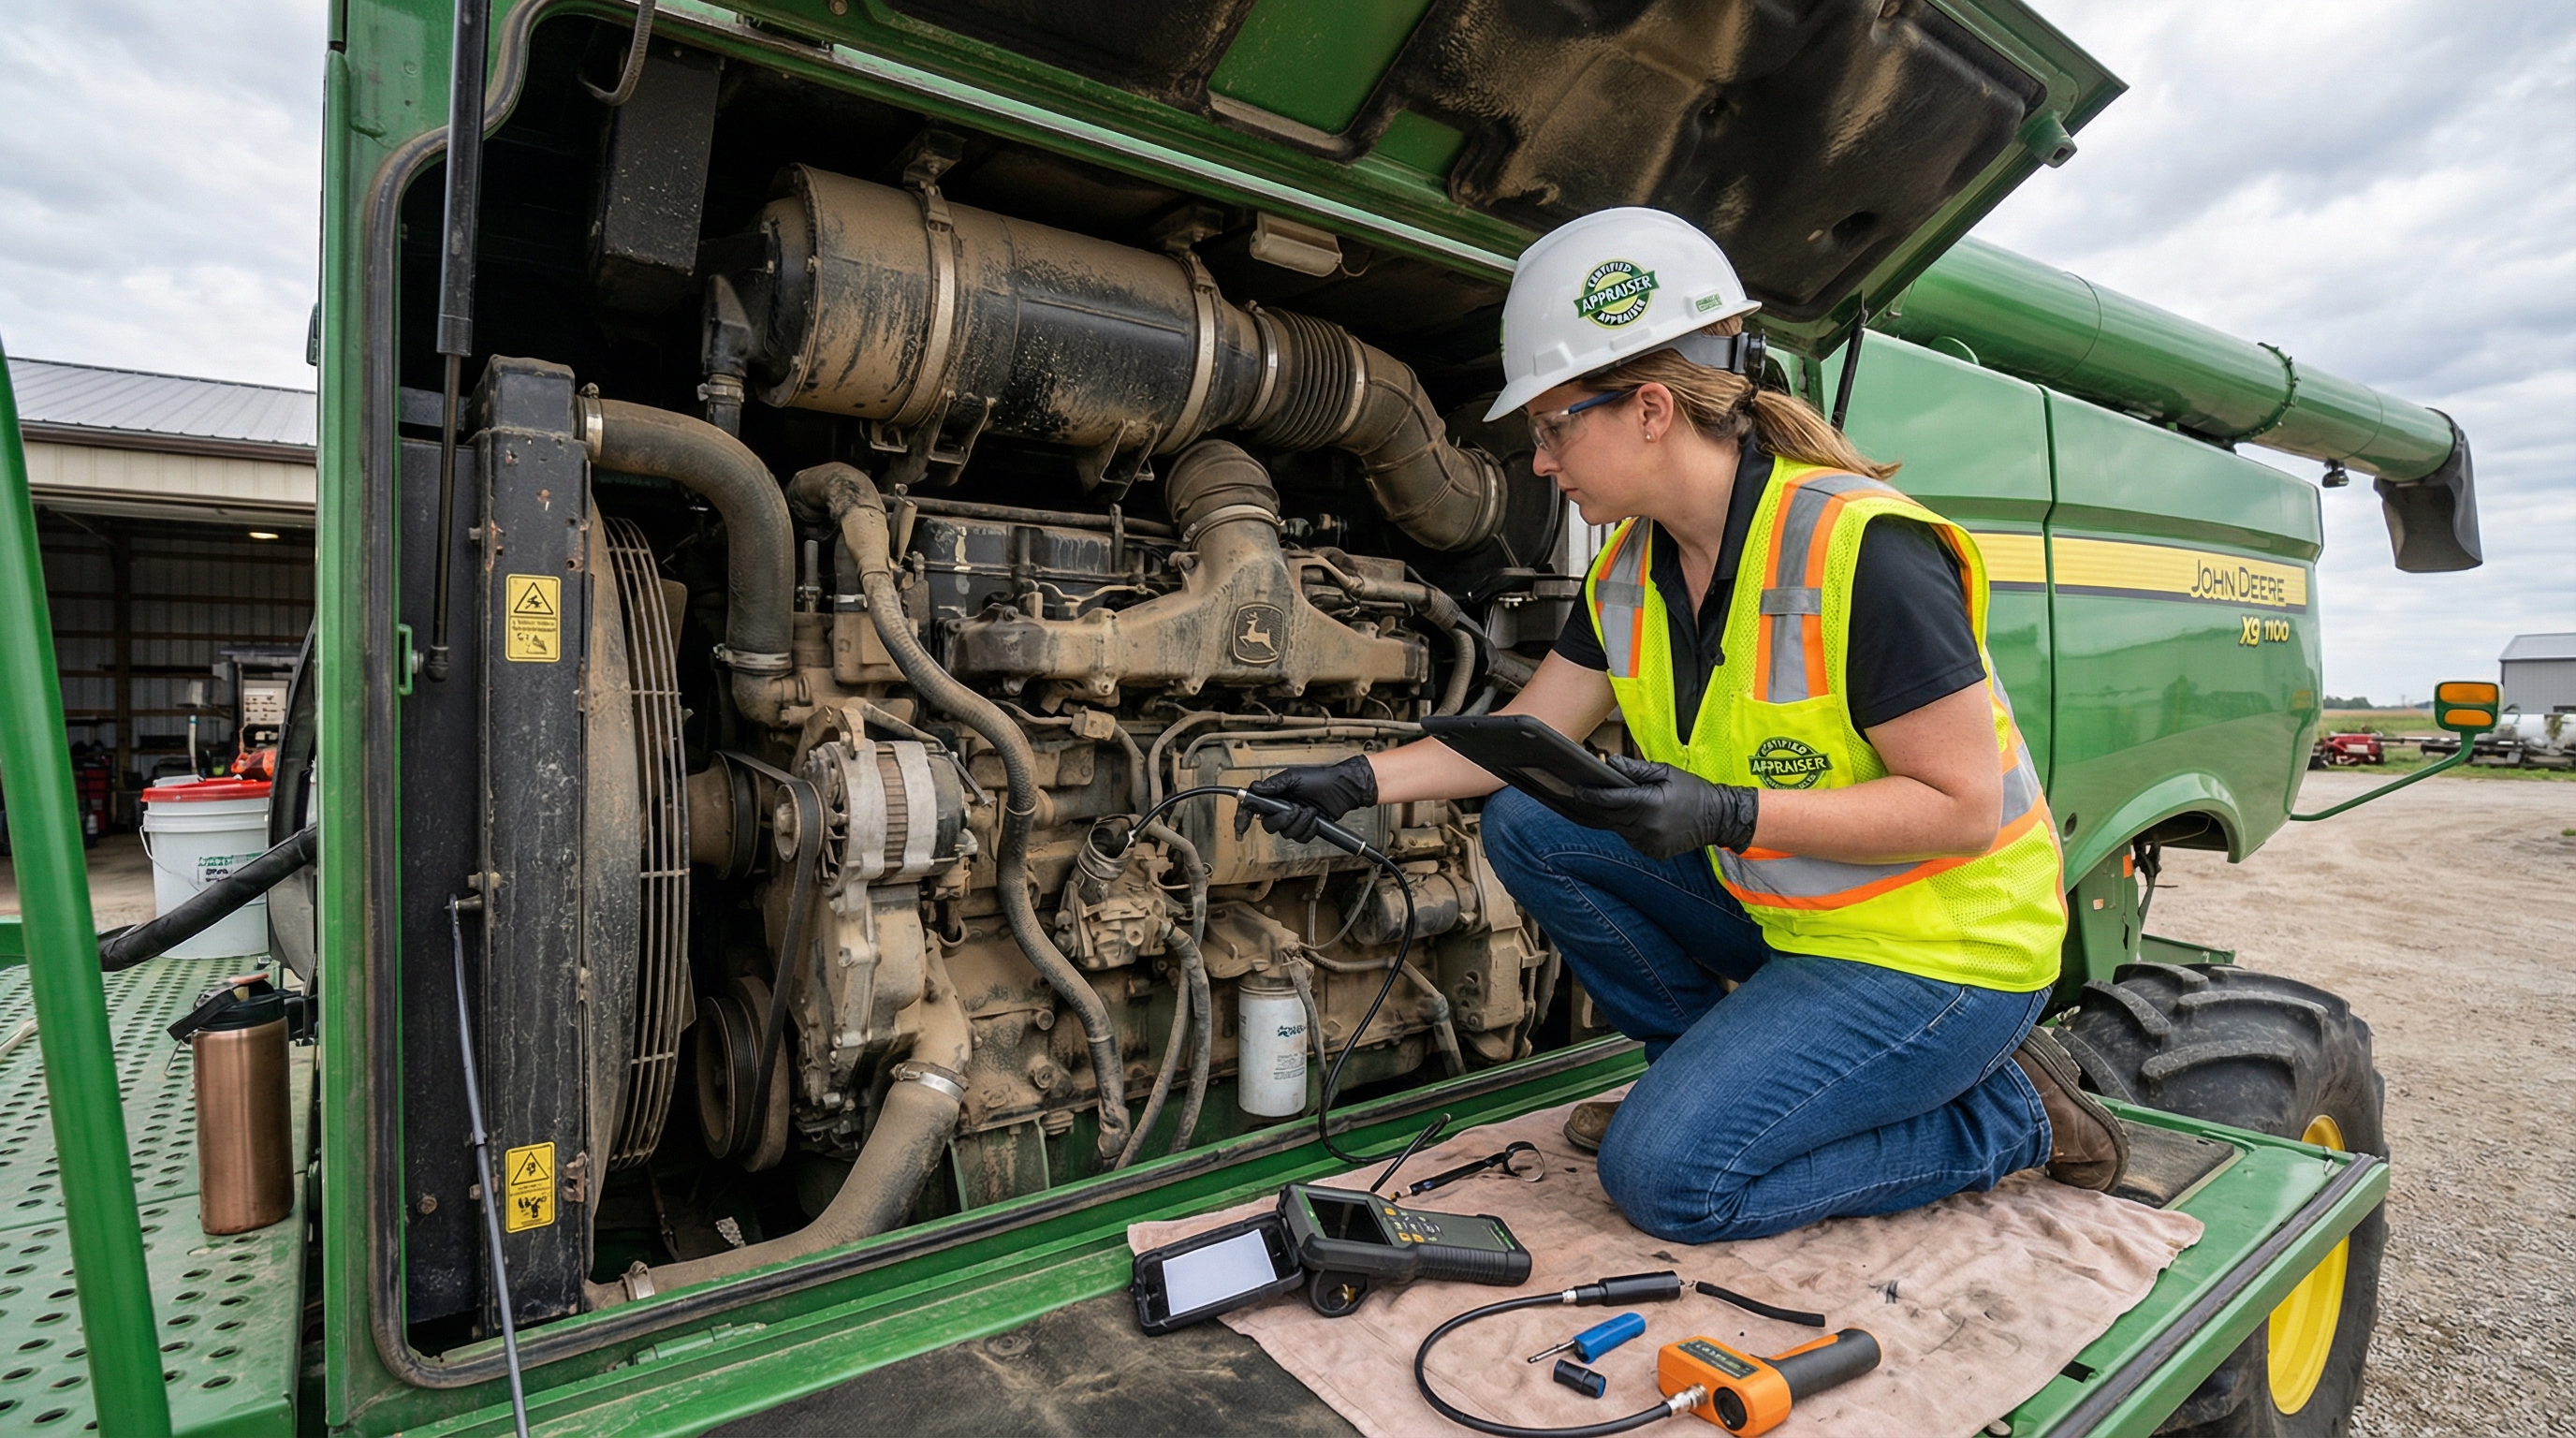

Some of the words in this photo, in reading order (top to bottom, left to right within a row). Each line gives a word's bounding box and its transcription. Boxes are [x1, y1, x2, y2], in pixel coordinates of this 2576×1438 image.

[1582, 275, 1652, 313] APPRAISER
[2191, 560, 2235, 596] JOHN
[2238, 566, 2285, 602] DEERE
[2239, 616, 2261, 646] X9
[2264, 620, 2290, 642] 1100
[1752, 757, 1826, 774] APPRAISER
